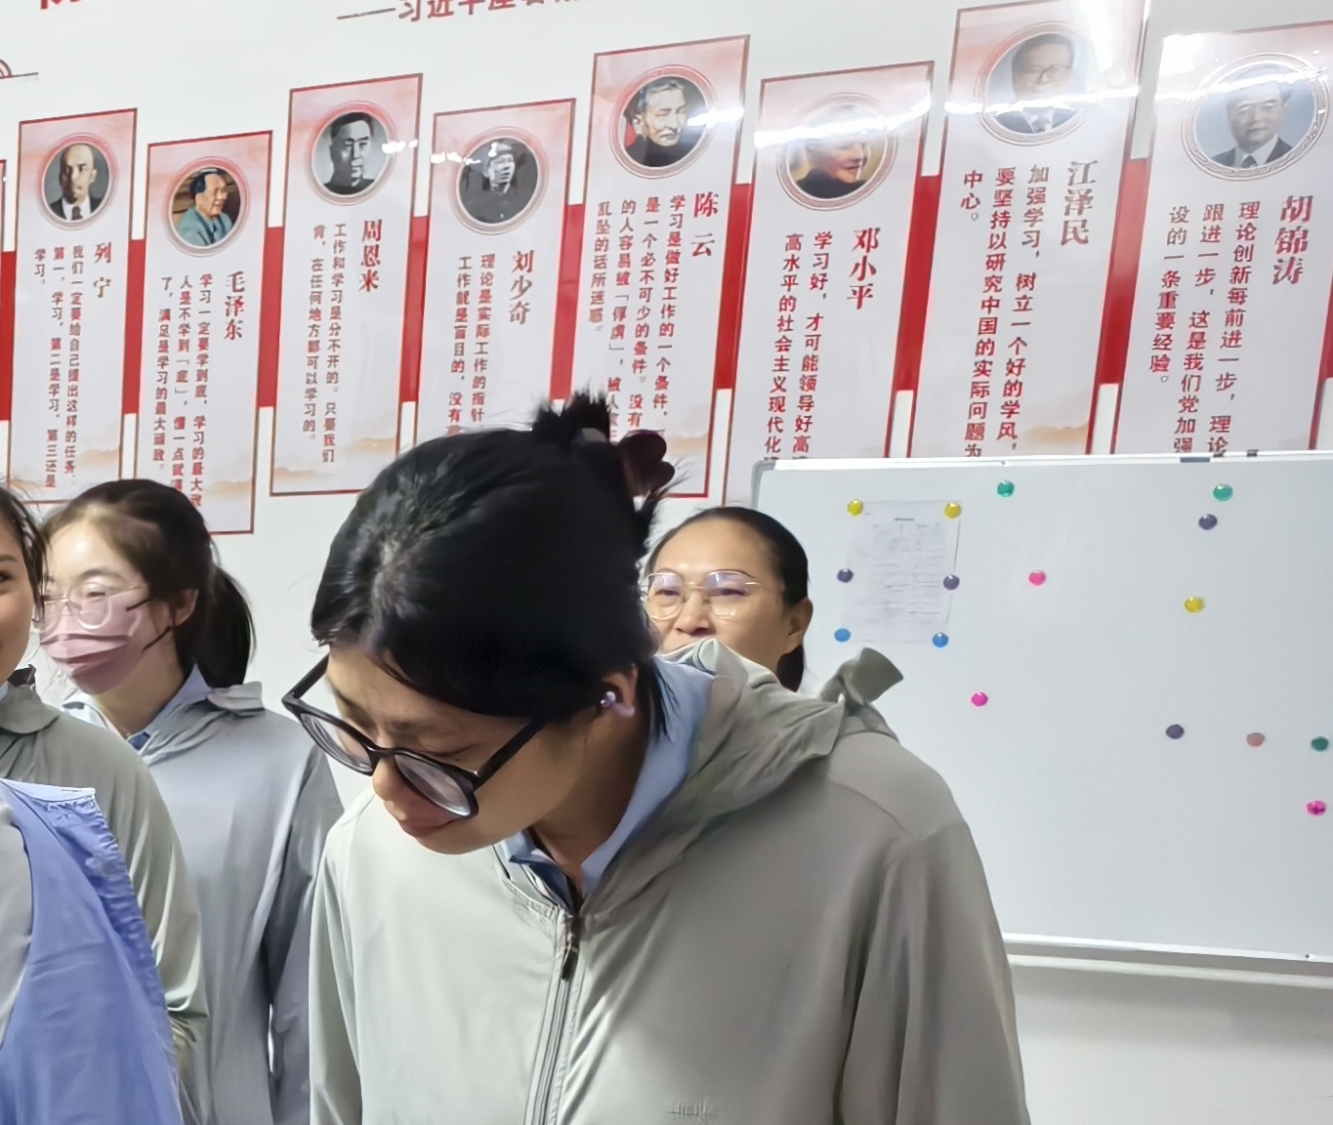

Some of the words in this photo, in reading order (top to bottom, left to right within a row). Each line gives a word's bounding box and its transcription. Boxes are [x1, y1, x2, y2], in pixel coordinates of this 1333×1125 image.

[690, 192, 719, 257] 陈云
[960, 170, 983, 221] 中心。
[1060, 160, 1098, 246] 江泽民
[93, 242, 112, 299] 列宁
[358, 219, 383, 292] 周恩来
[847, 228, 880, 310] 邓小平
[1273, 195, 1313, 285] 胡锦涛
[224, 271, 246, 341] 毛泽东
[509, 250, 535, 325] 刘少奇
[628, 197, 660, 432] 是一个必不可少的条件。没有
[652, 194, 685, 436] 学习是做好工作的一个条件，
[1150, 206, 1190, 383] 设的一条重要经验。
[763, 233, 804, 460] 高水平的社会主义现代化
[792, 231, 833, 459] 学习好，才可能领导好高
